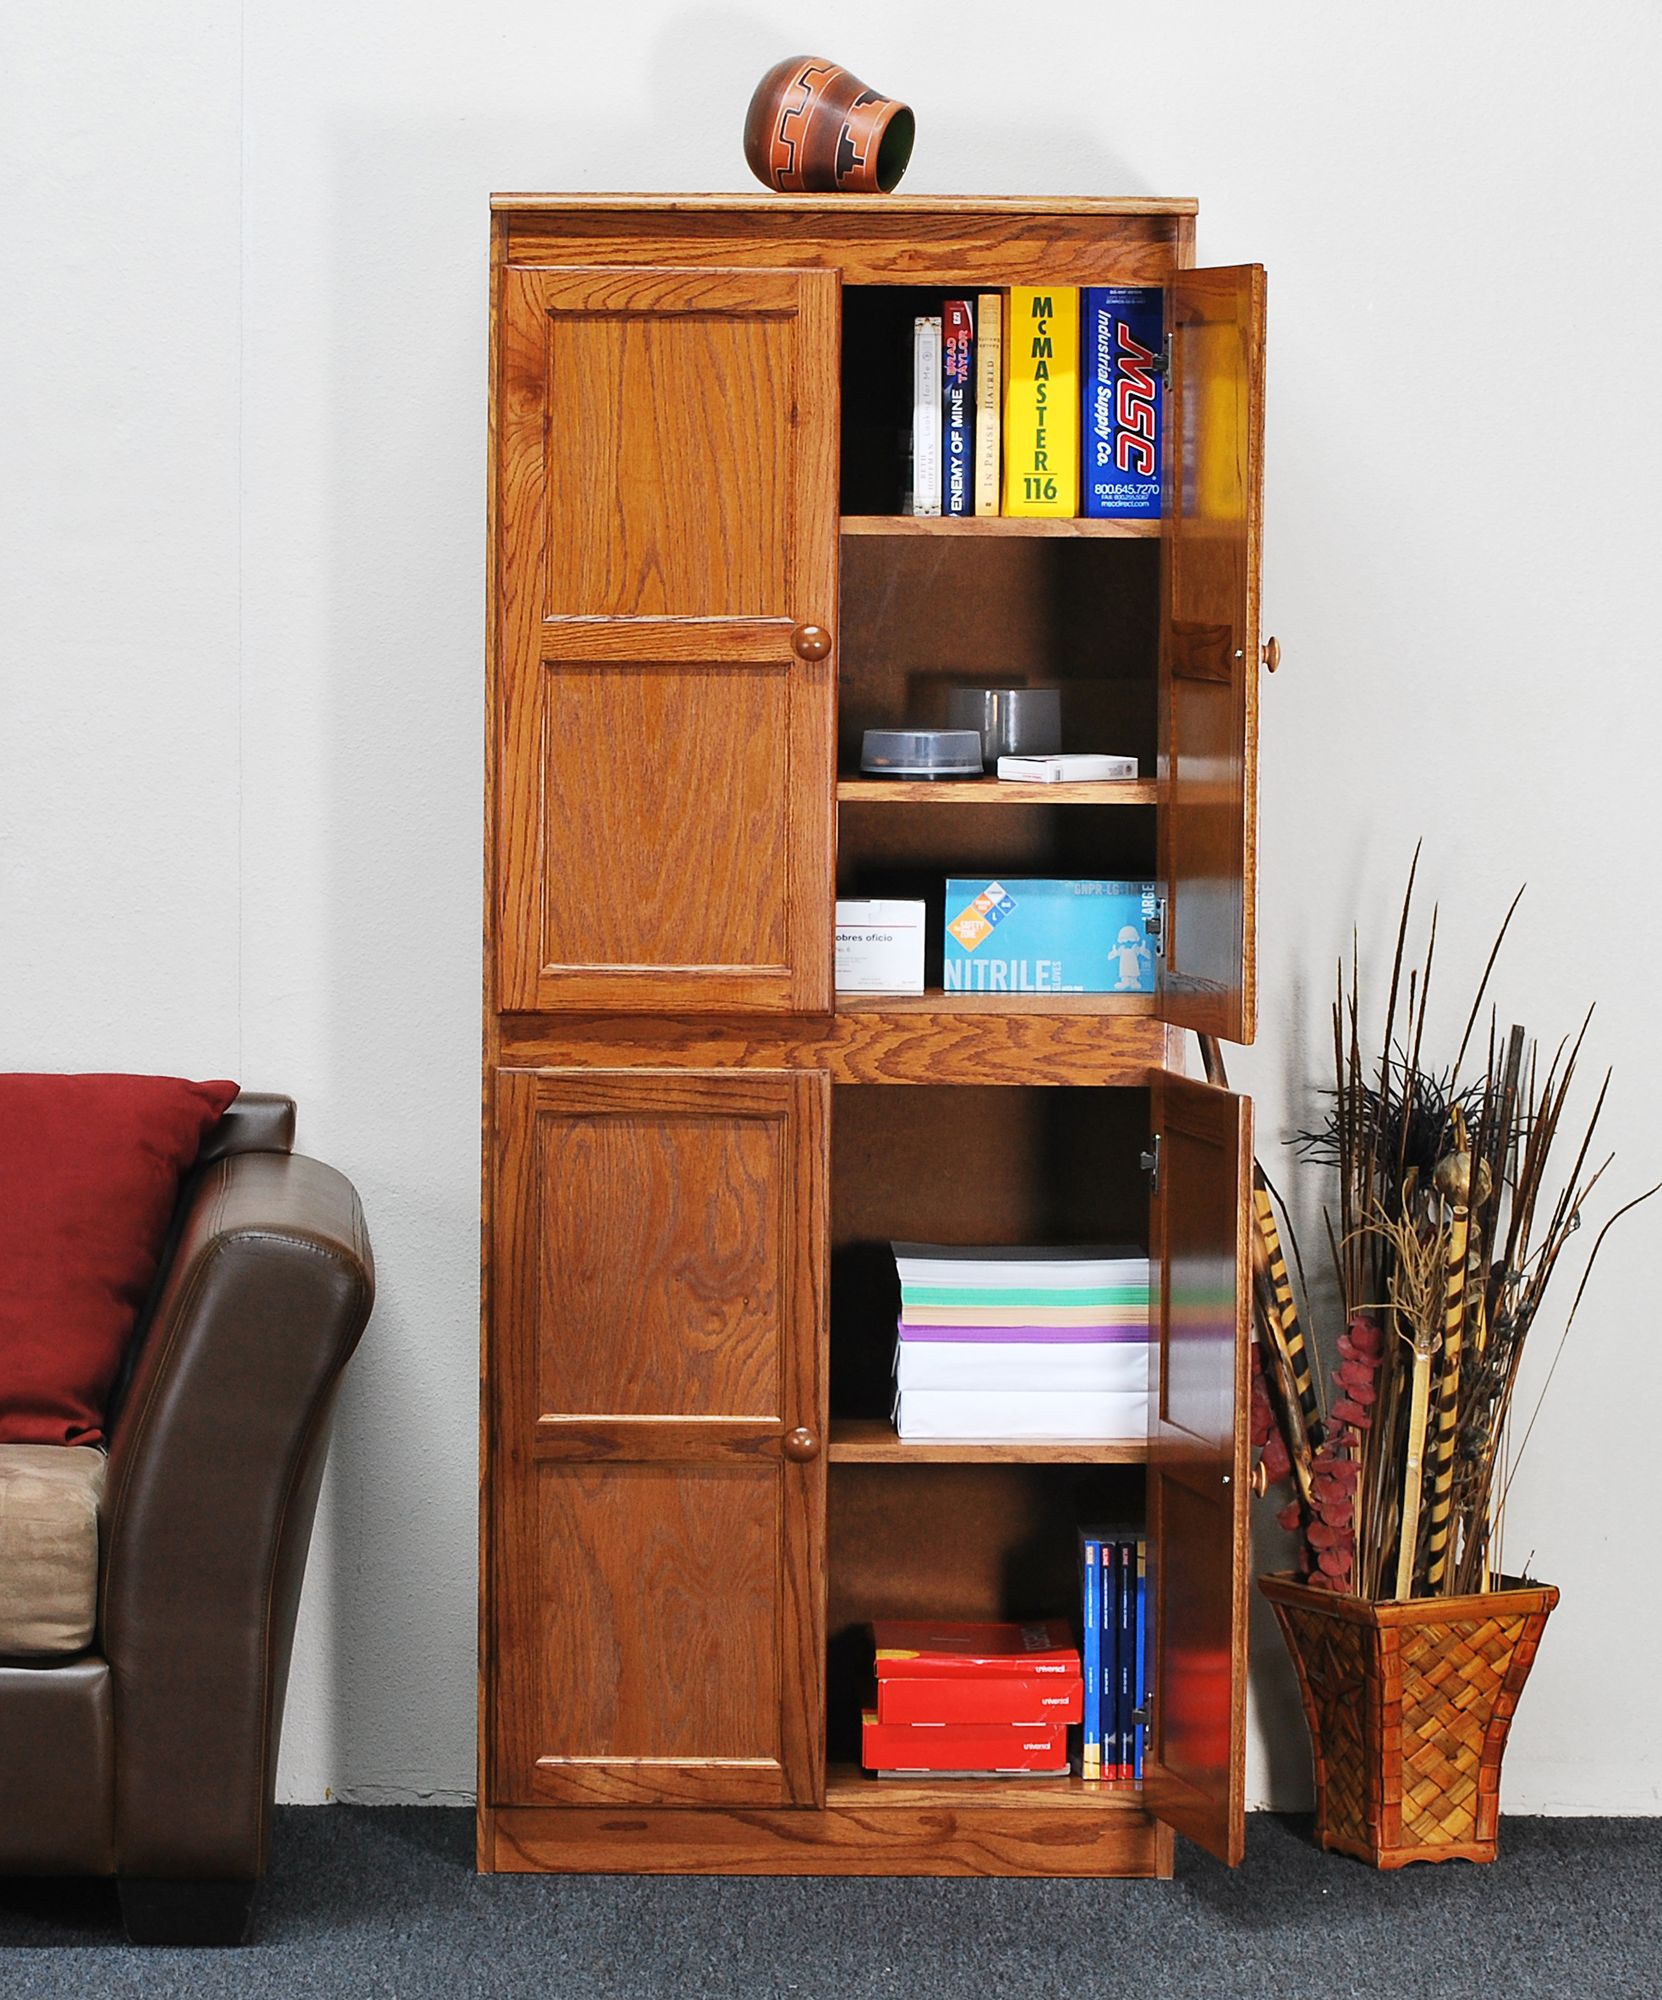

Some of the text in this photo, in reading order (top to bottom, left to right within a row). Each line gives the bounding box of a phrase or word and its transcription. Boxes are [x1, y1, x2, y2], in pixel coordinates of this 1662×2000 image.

[946, 338, 957, 376] BRAD
[957, 329, 969, 384] TAYLOR
[1094, 309, 1112, 467] Industrial Supply Co.
[1117, 322, 1156, 477] MSC
[951, 389, 963, 511] ENEMY OF MINE
[1024, 477, 1057, 500] 116
[1095, 484, 1159, 494] 800.645.7270
[836, 933, 893, 942] obres oficio
[946, 959, 1051, 991] NITRILE
